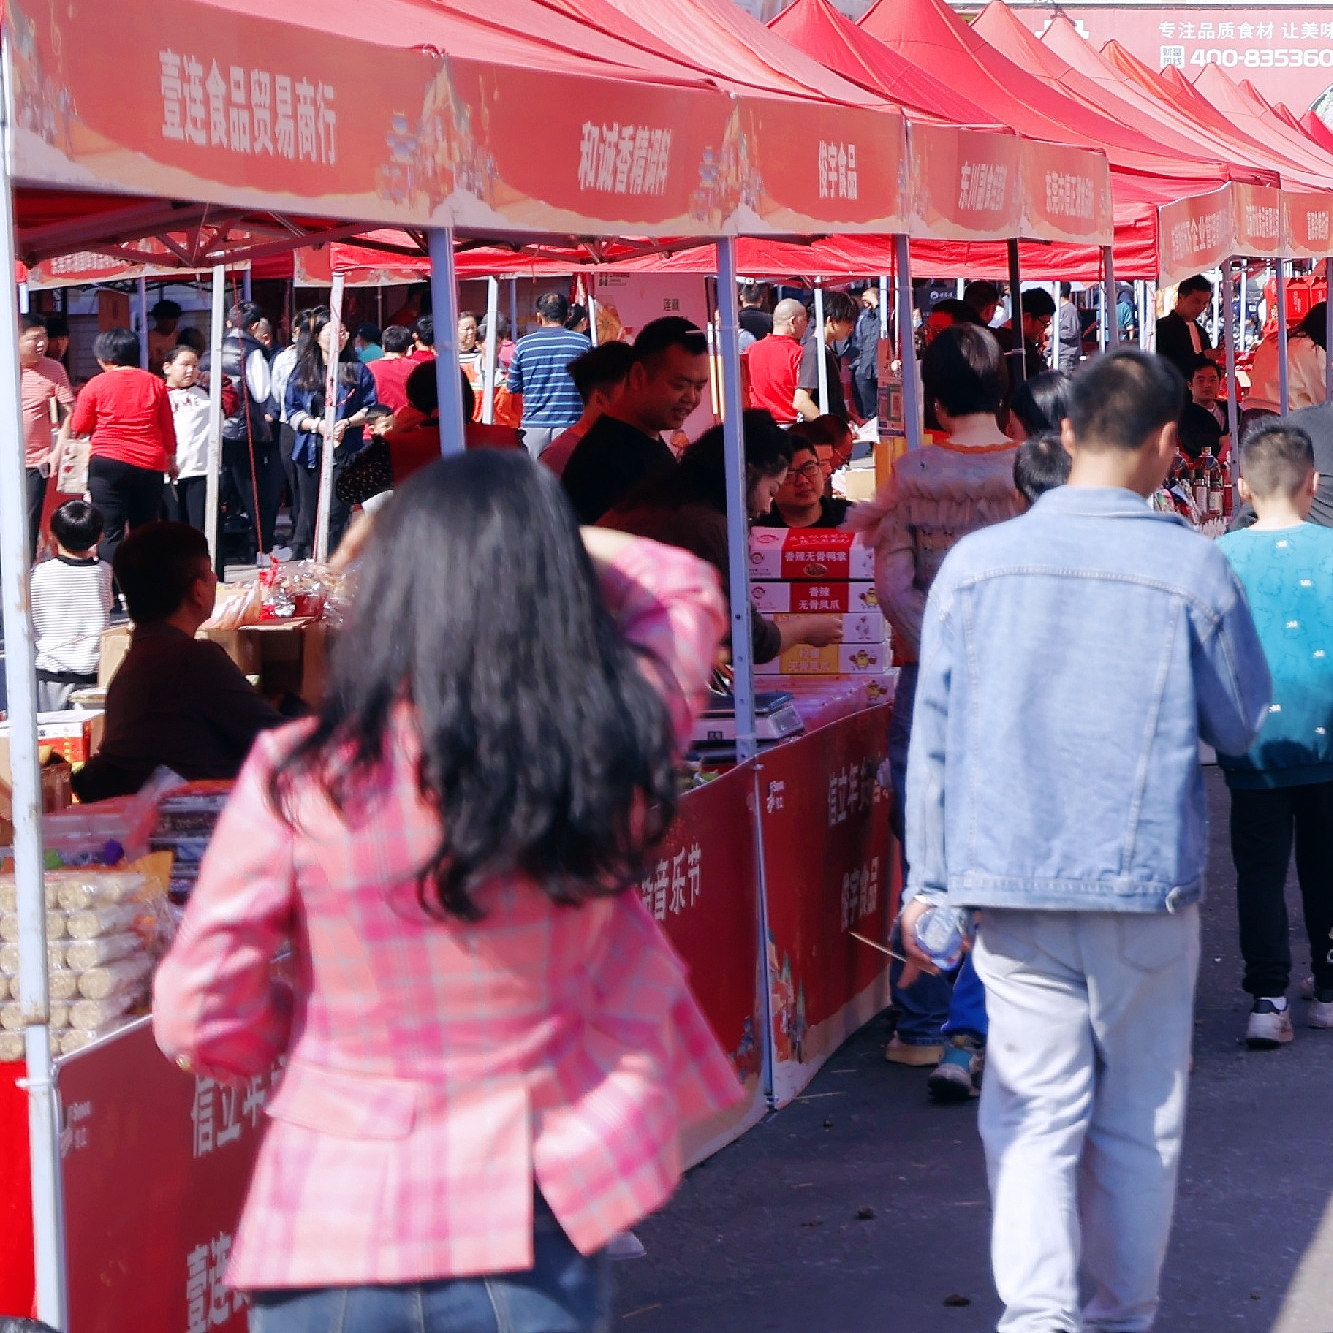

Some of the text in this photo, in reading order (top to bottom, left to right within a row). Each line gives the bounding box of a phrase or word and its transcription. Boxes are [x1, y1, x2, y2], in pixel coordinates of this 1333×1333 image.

[1158, 21, 1274, 40] 专注品质食材
[158, 47, 337, 166] 壹连食品贸易商行
[190, 1055, 288, 1159] 信立年
[186, 1230, 250, 1333] 壹连
